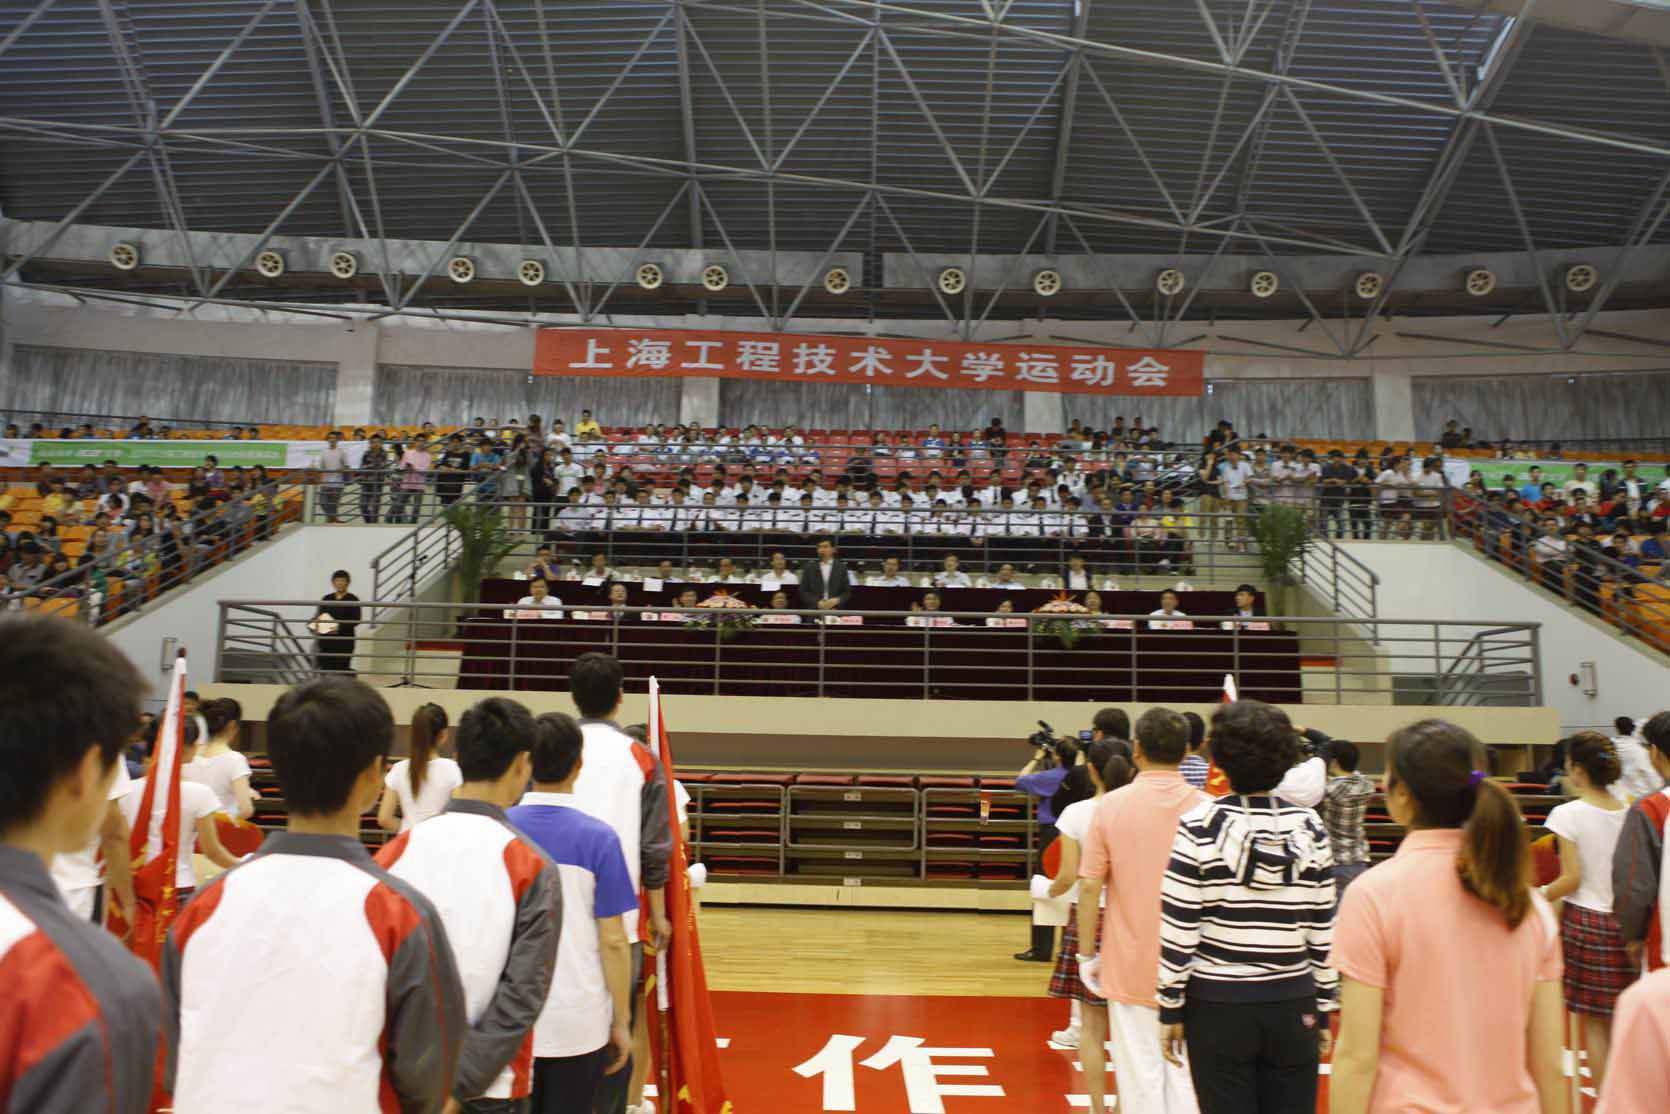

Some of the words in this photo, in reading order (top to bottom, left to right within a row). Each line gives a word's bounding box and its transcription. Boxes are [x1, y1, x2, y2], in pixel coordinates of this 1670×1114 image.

[568, 338, 1170, 388] 上海工程技术大学运动会
